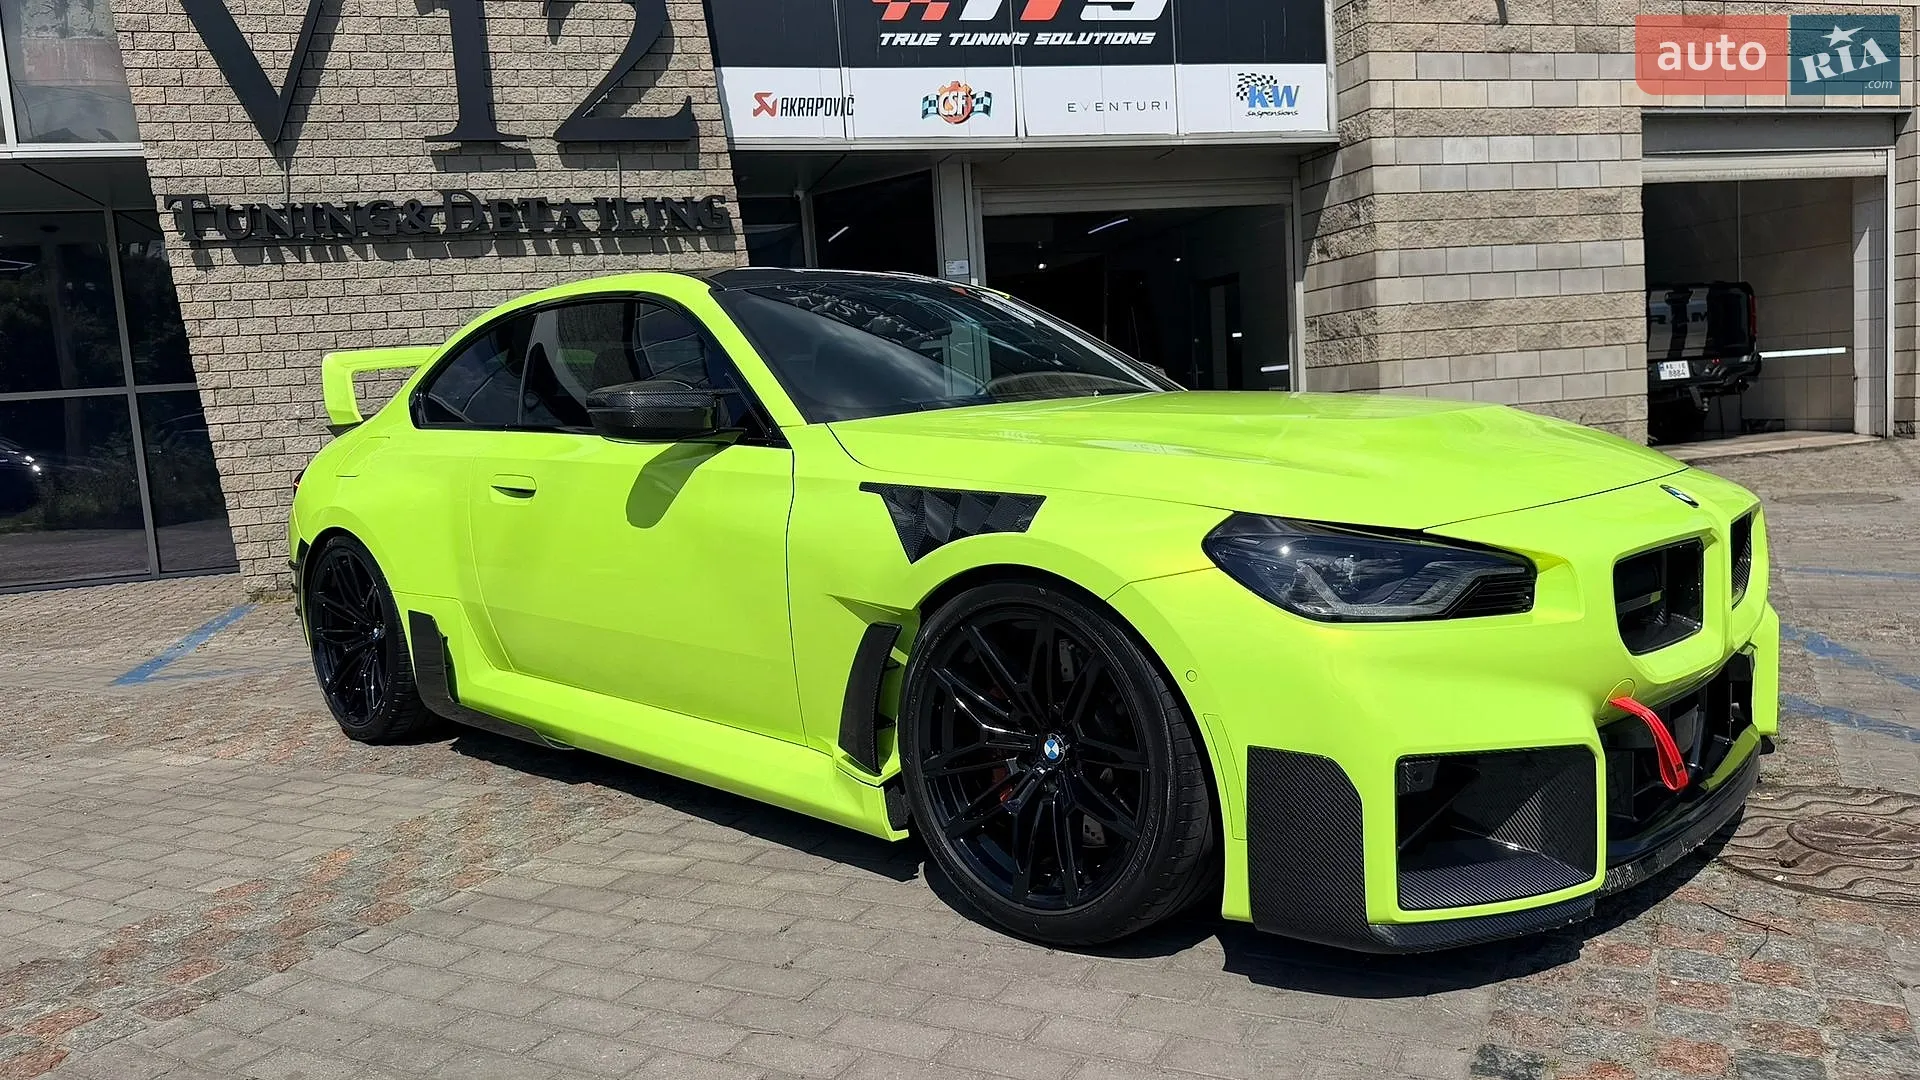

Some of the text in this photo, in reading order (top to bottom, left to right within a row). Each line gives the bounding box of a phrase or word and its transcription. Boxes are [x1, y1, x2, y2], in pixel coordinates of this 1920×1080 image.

[880, 32, 1156, 46] TRUE TUNING SOLUTIONS
[939, 91, 967, 115] CSF
[1248, 85, 1300, 108] KW
[1067, 101, 1168, 112] EVENTURI
